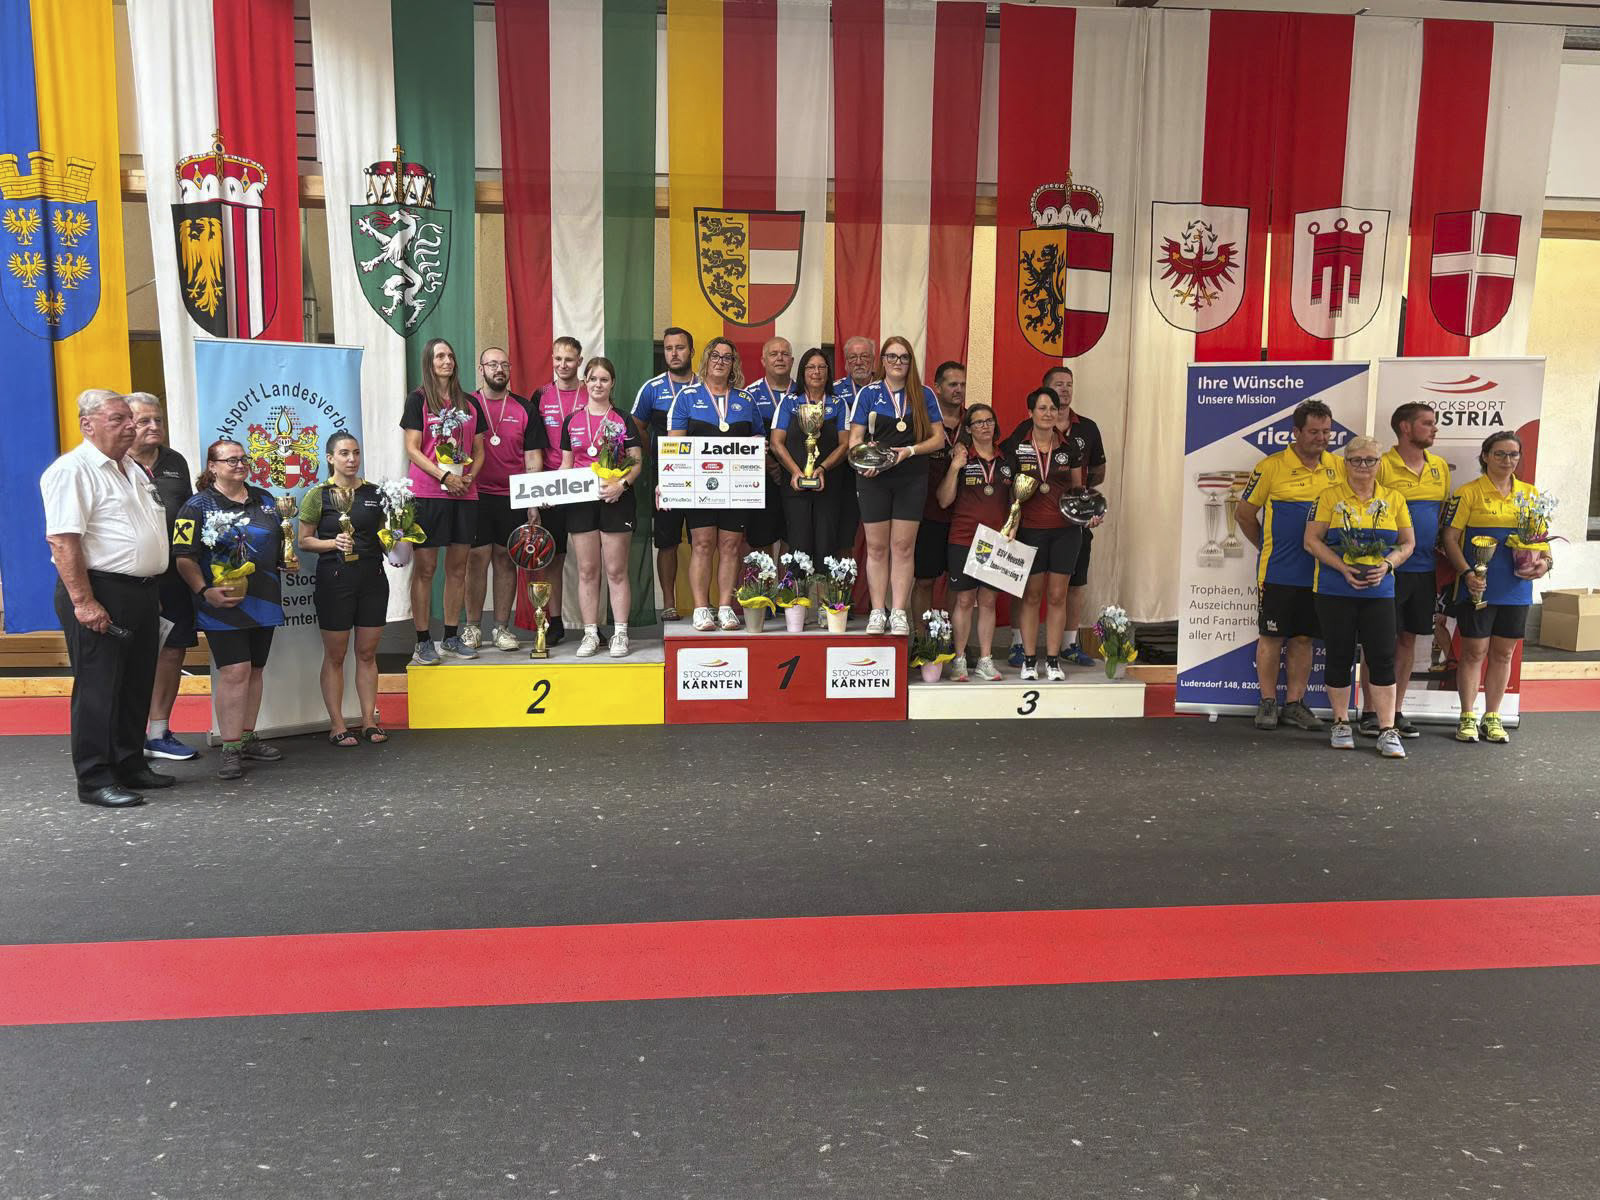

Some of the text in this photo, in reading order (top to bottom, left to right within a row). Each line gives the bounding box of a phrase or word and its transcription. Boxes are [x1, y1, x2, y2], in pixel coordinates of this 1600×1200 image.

[1197, 375, 1304, 389] Ihre Wünsche
[1197, 394, 1276, 405] Unsere Mission
[1411, 400, 1506, 411] OCKSPORT
[701, 442, 759, 455] Ladler
[515, 478, 594, 500] Ladler
[996, 548, 1008, 559] ESV
[1190, 584, 1244, 596] Trophäen,
[1189, 600, 1259, 612] Auszeichnun
[1189, 616, 1210, 625] und
[1188, 630, 1236, 641] aller Art!
[682, 670, 742, 679] STOCKSPORT
[777, 655, 801, 690] 1
[832, 669, 889, 677] STOCKSPORT
[682, 676, 743, 690] KÄRNTEN
[831, 675, 890, 688] KÄRNTEN
[1180, 679, 1222, 688] Ludersdorf
[1224, 681, 1240, 690] 148,
[526, 679, 551, 714] 2
[1017, 690, 1040, 716] 3
